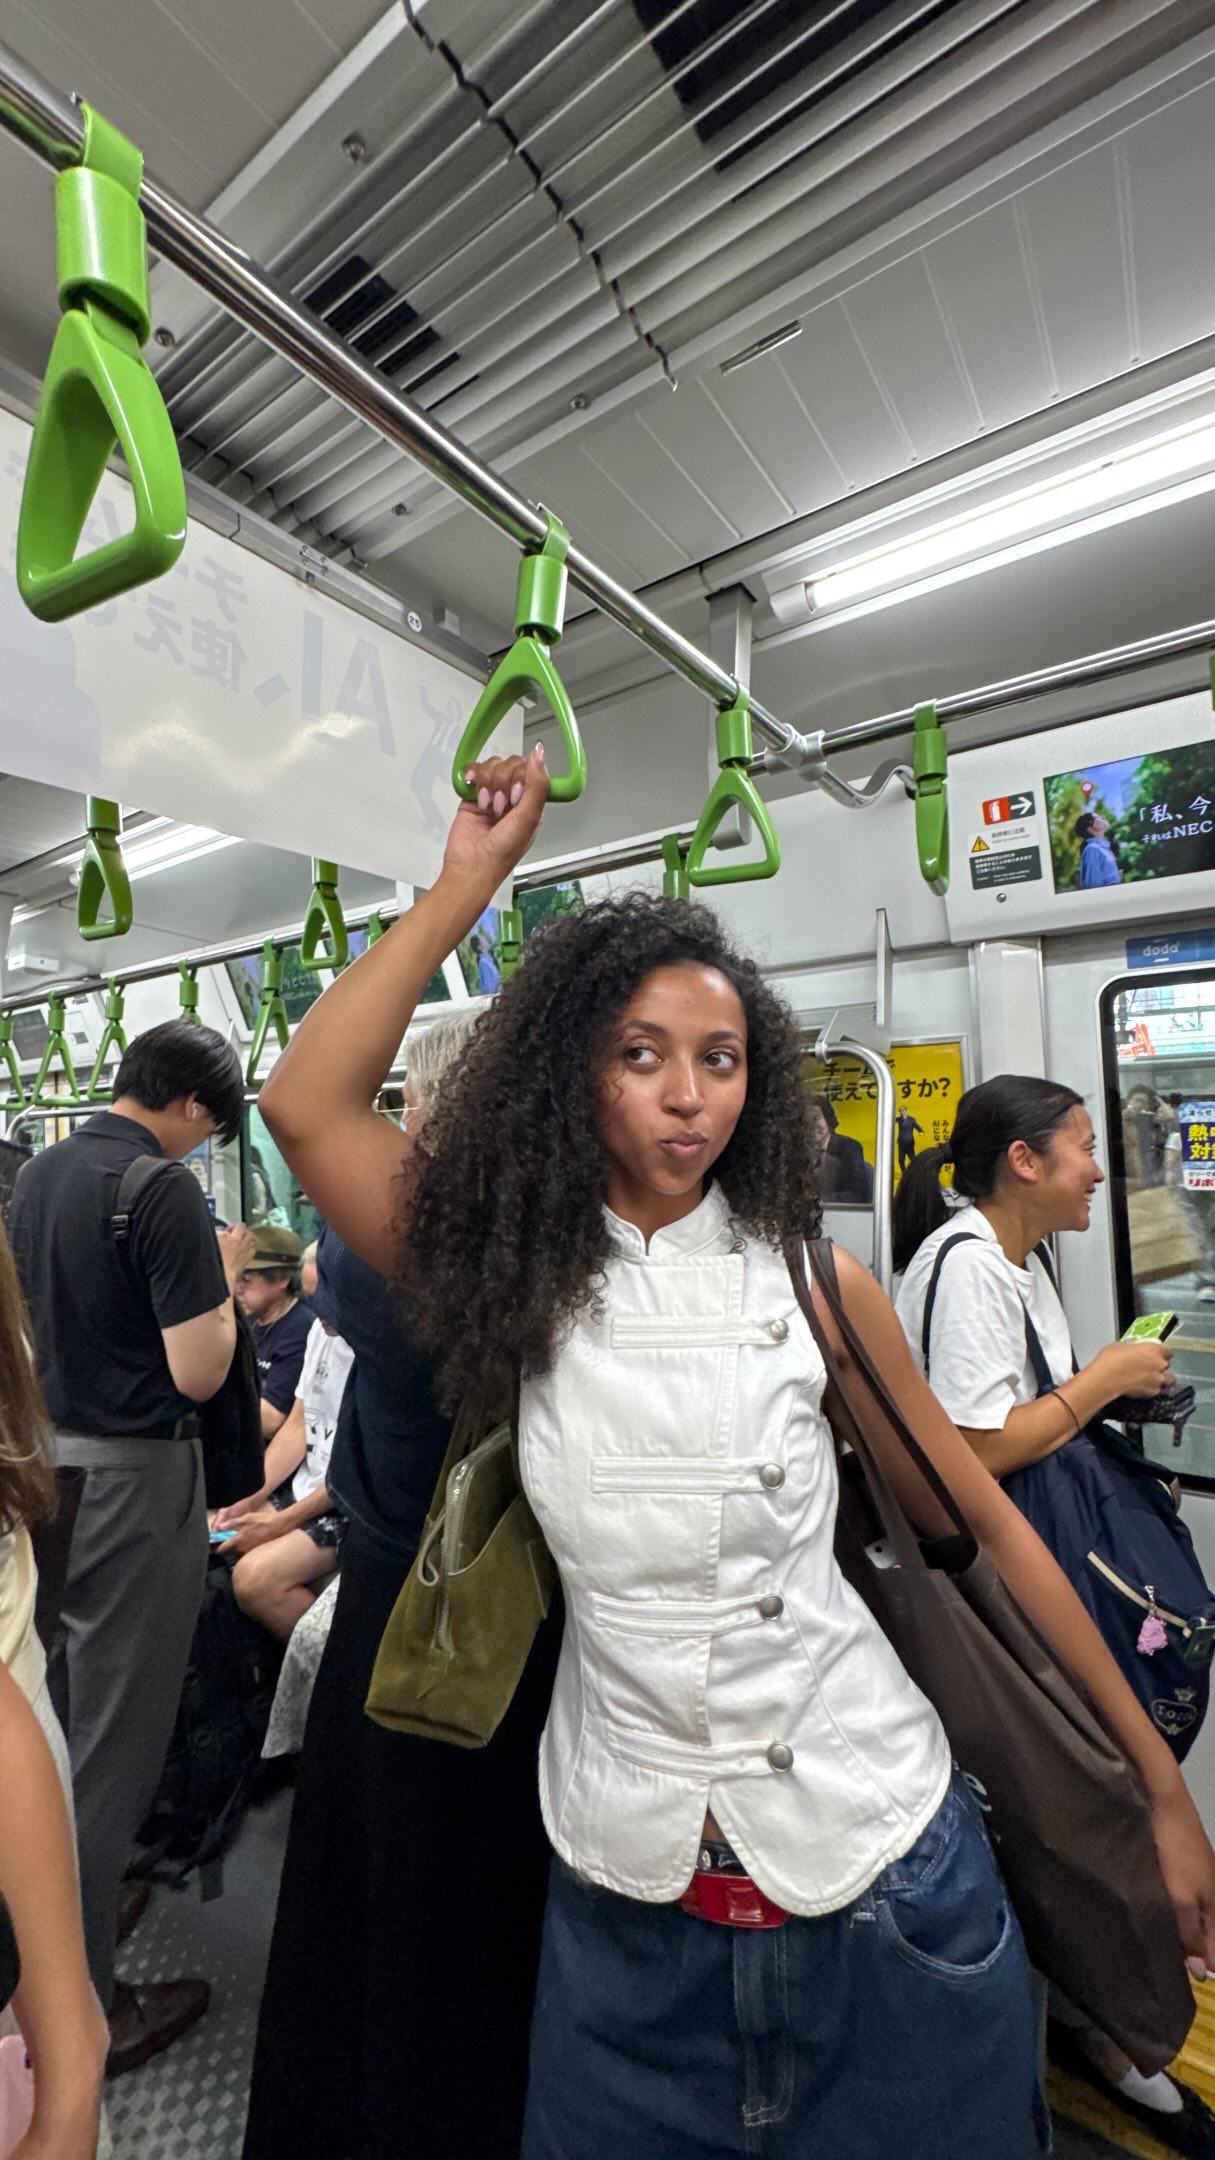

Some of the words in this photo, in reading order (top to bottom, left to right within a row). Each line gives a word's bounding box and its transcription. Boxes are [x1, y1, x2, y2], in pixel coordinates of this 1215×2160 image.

[1143, 944, 1179, 956] doda
[823, 1077, 951, 1102] 使えてすか?
